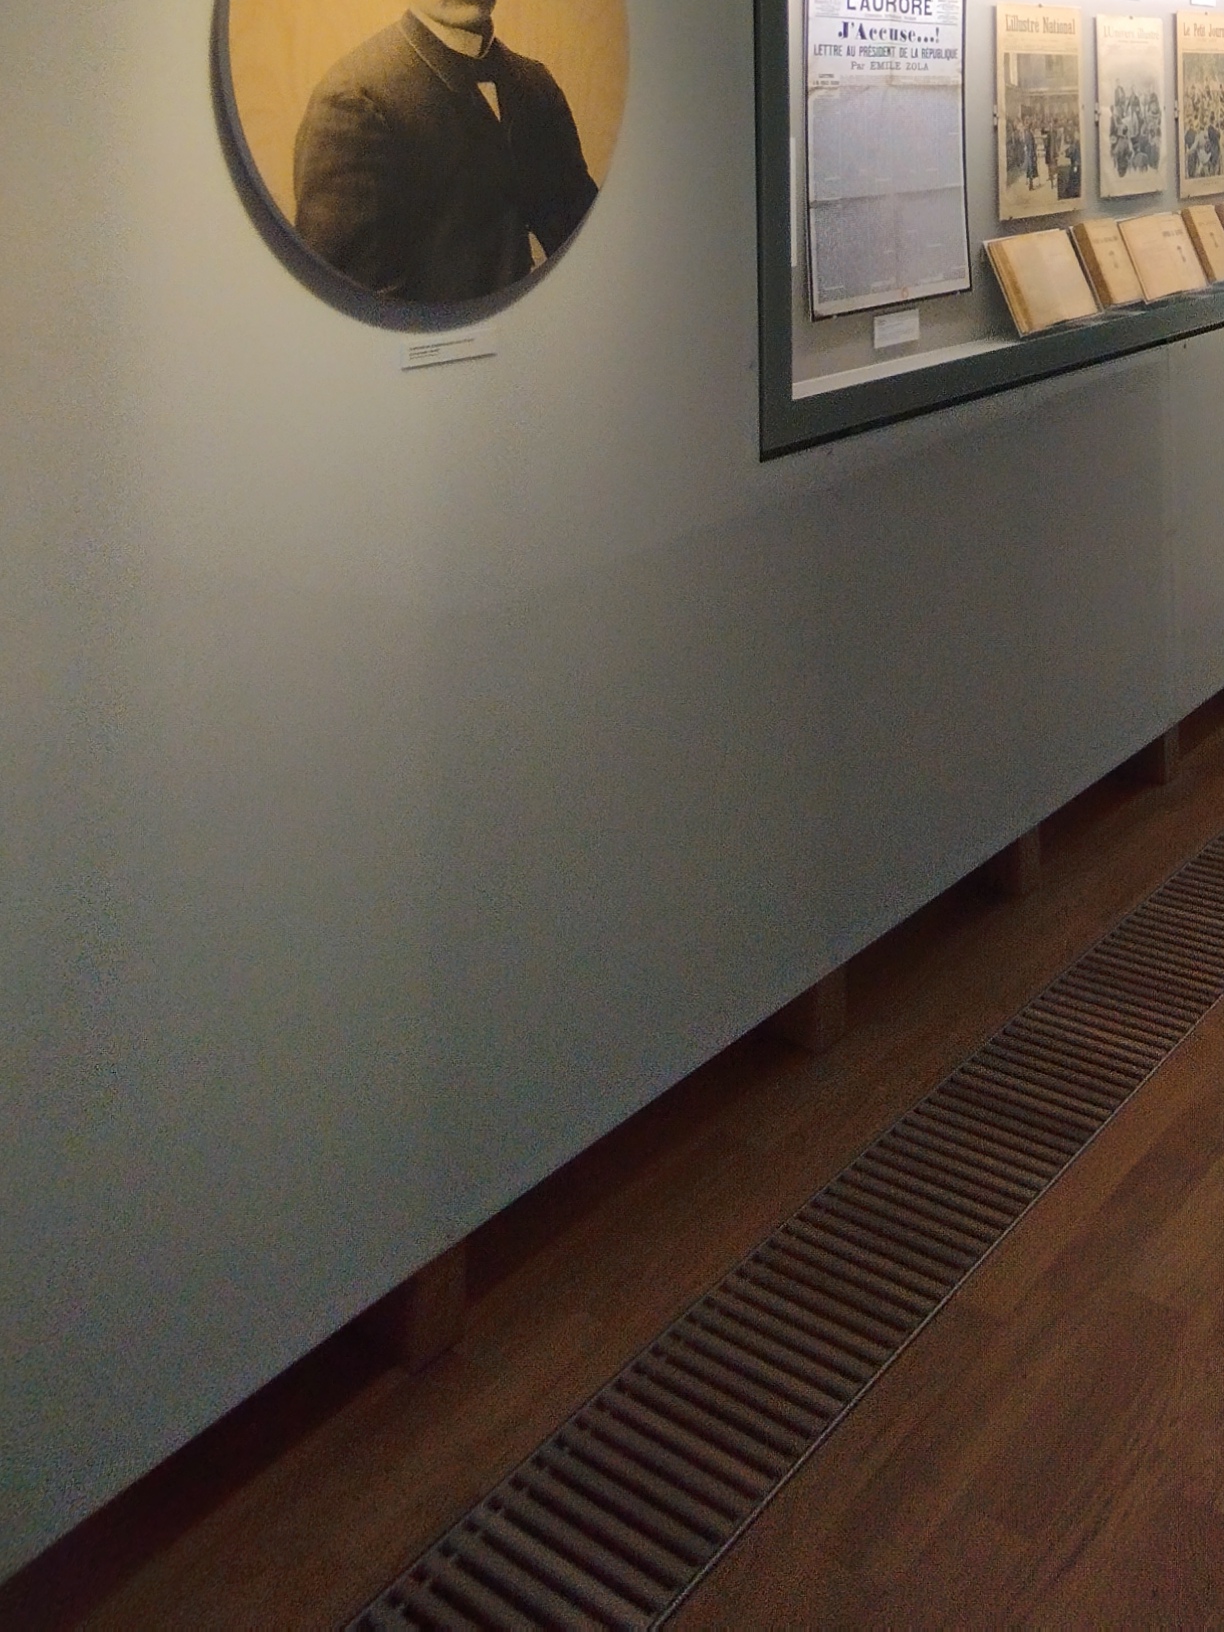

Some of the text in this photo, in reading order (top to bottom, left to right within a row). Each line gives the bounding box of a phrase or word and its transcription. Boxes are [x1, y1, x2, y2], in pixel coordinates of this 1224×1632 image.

[1043, 16, 1076, 35] National
[1183, 22, 1190, 36] Le
[1193, 22, 1206, 37] Petit
[814, 44, 842, 57] LETTRE
[846, 46, 856, 57] AU
[899, 47, 908, 59] DE
[911, 49, 919, 59] LA
[851, 61, 865, 70] Par
[906, 62, 929, 71] ZOLA
